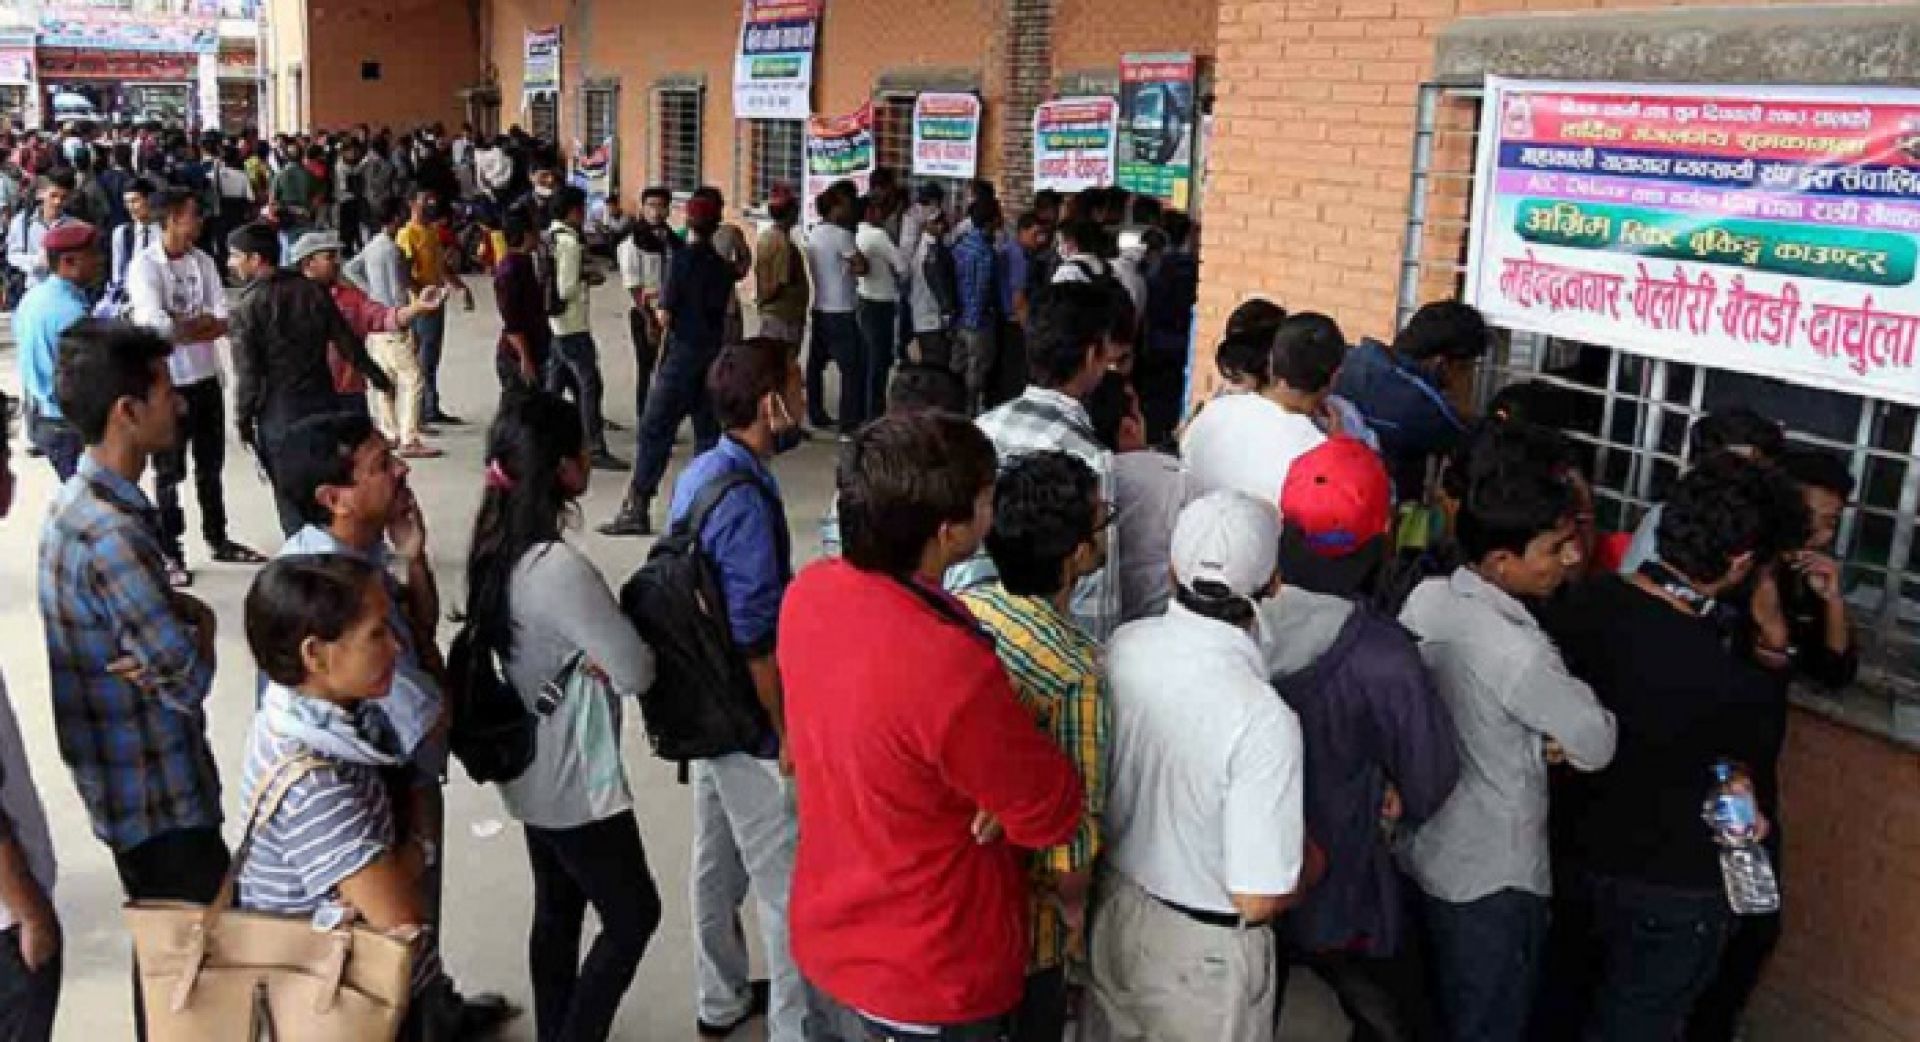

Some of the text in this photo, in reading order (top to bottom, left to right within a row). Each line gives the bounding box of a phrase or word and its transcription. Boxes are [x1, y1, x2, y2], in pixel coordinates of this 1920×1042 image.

[1525, 202, 1612, 242] अग्रिम
[1773, 242, 1889, 276] काउण्टर
[1809, 292, 1920, 377] दार्चुला
